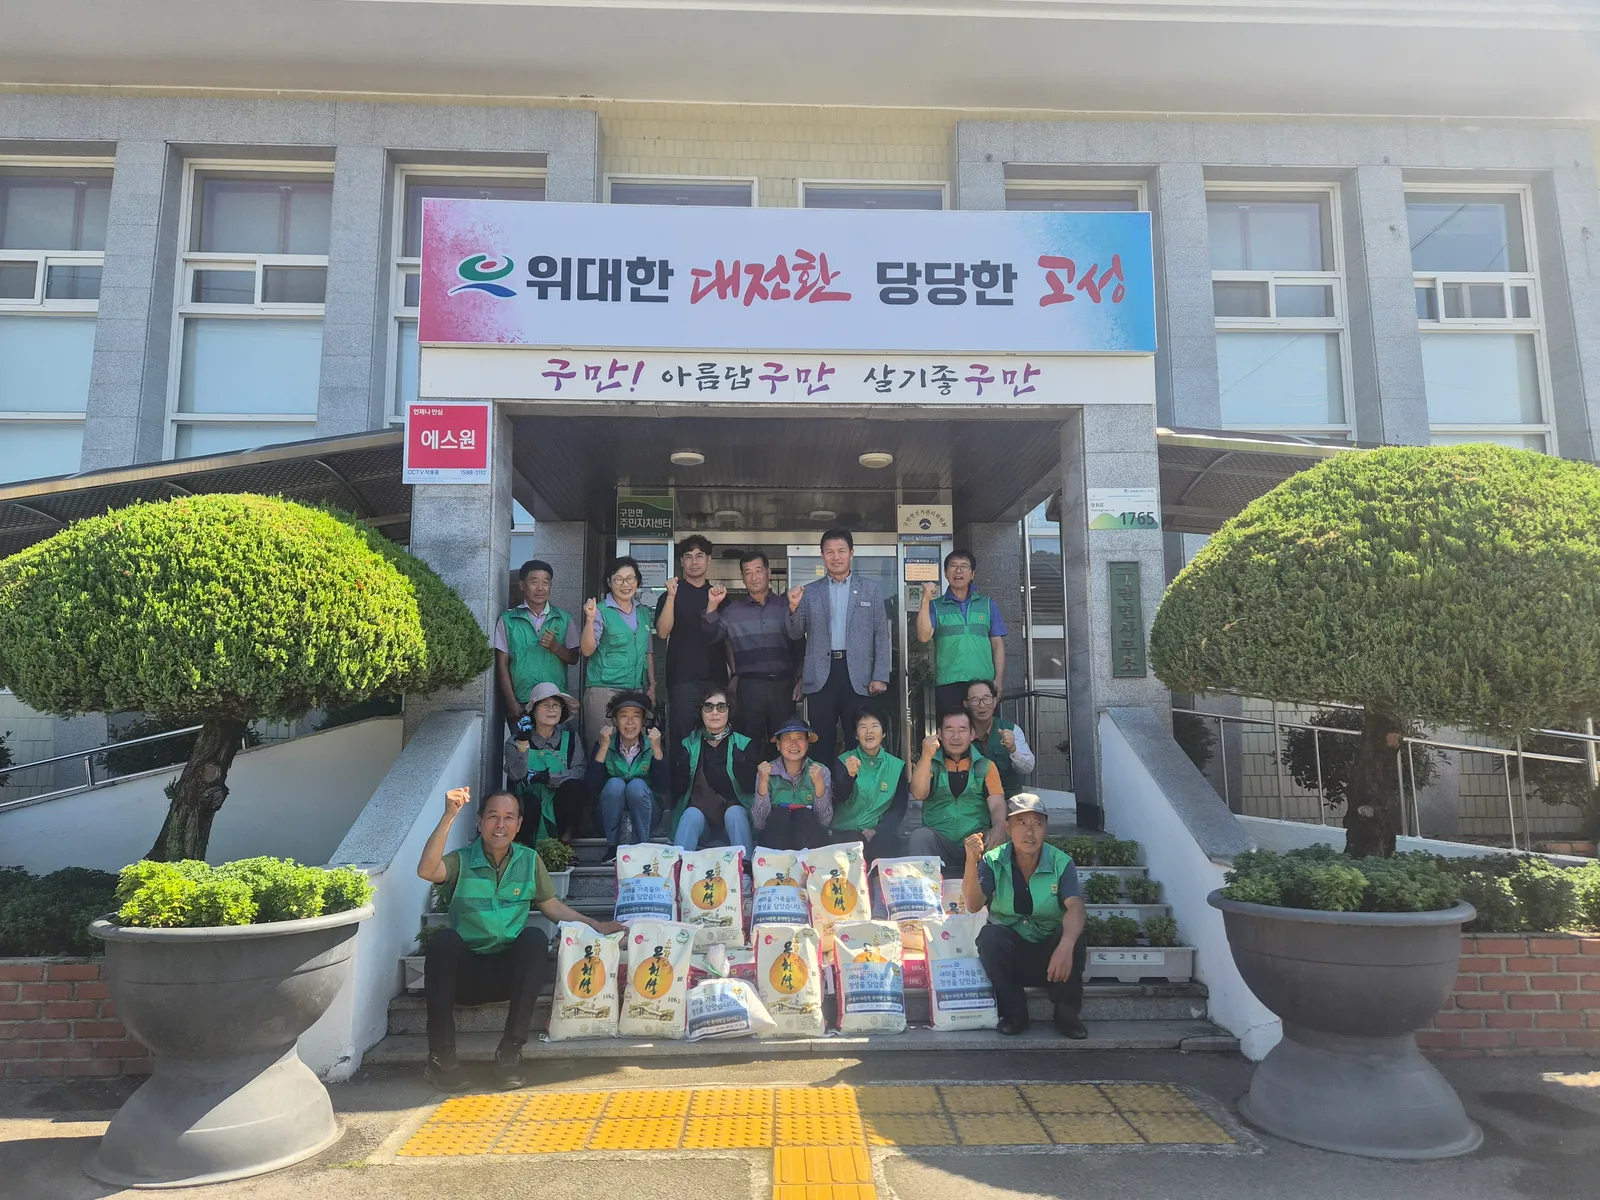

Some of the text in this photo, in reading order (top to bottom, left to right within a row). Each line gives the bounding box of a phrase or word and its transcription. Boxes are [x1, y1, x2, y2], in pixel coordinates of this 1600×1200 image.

[526, 248, 1126, 307] 위대한 대전환 당당한 고성
[541, 358, 1042, 397] 구만! 아름답구만 살기좋구만
[413, 408, 430, 416] 언제나
[420, 429, 476, 450] 에스원
[620, 508, 643, 517] 구만면
[1120, 511, 1155, 526] 1765
[620, 518, 671, 528] 주민자치센터
[1115, 566, 1140, 672] 구만면사무소
[958, 969, 982, 977] 가족들의
[939, 977, 988, 987] 정성을 담았습니다.
